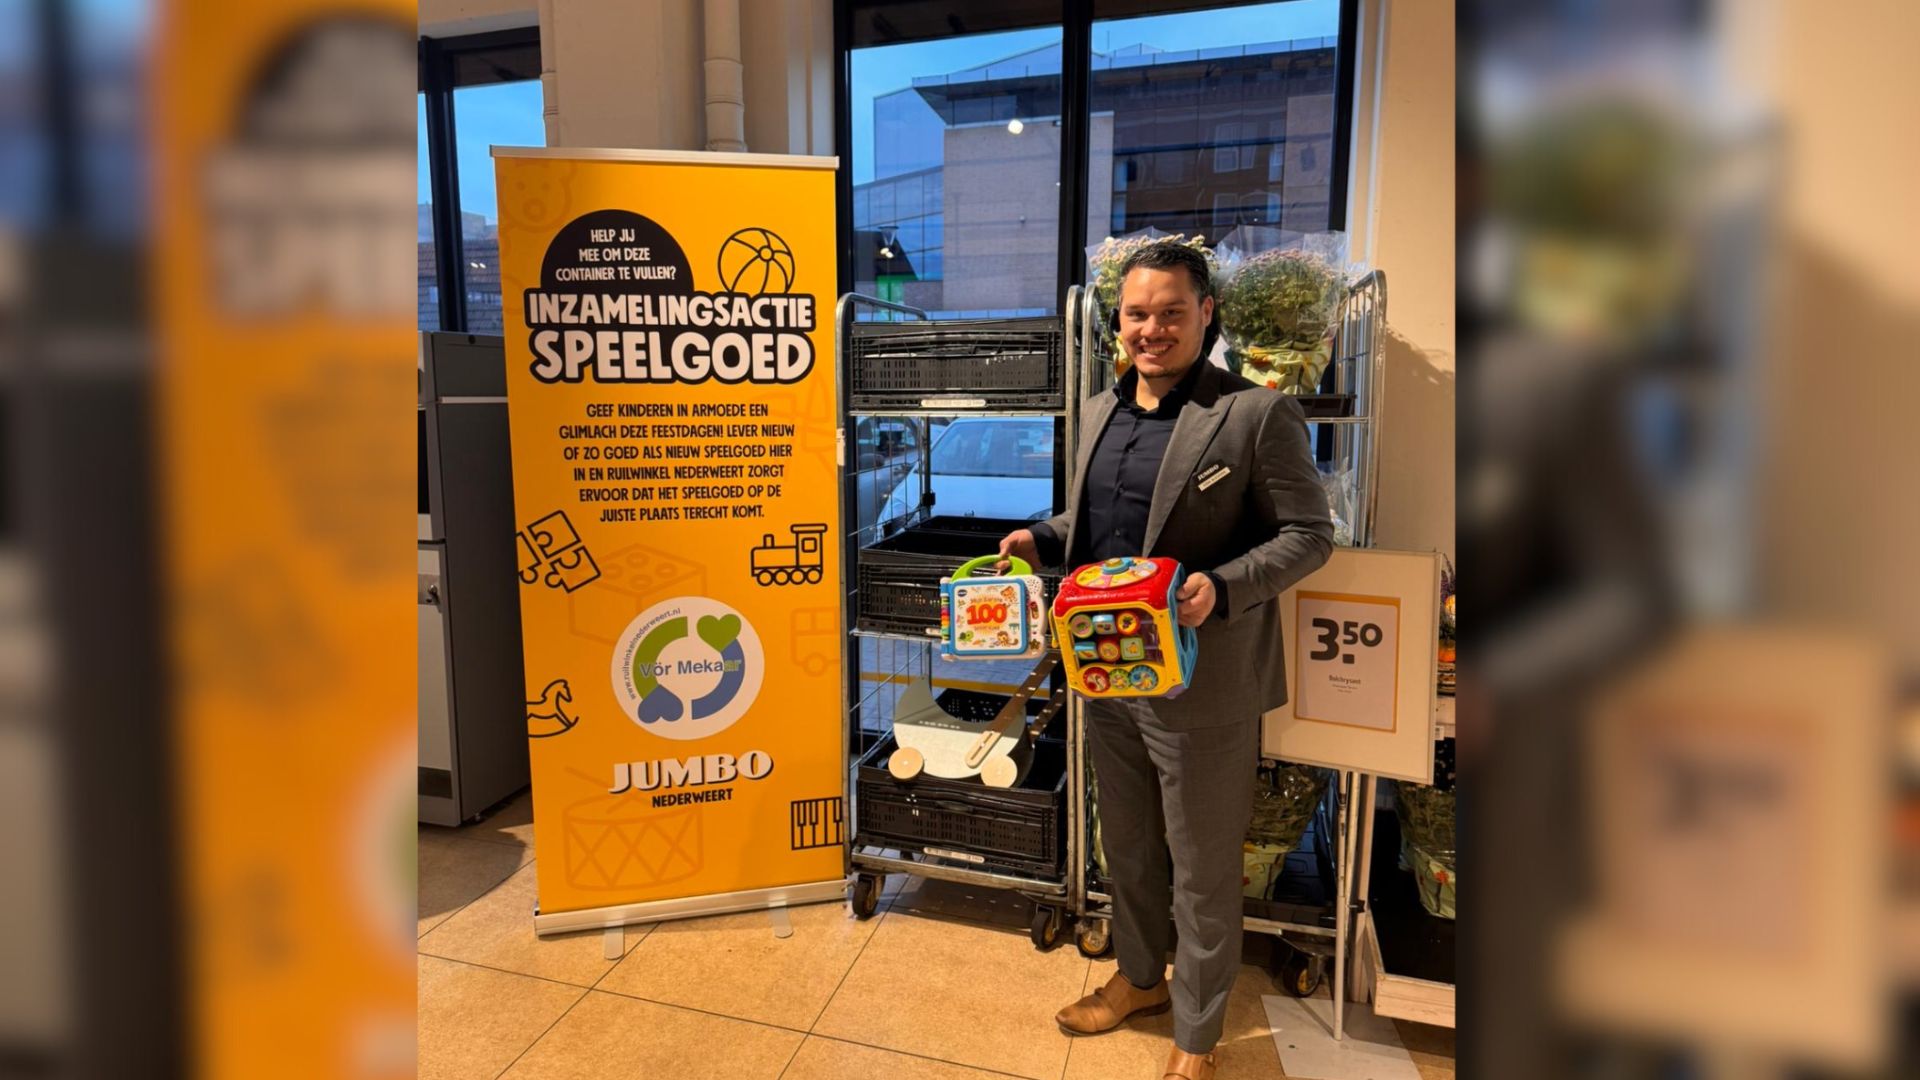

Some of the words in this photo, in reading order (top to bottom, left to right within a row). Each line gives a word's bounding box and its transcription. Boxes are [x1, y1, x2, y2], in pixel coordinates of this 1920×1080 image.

[590, 229, 616, 243] HELP
[619, 229, 635, 242] JIJ
[579, 248, 600, 262] MEE
[602, 248, 621, 261] OM
[624, 247, 650, 261] DEZE
[556, 267, 615, 281] CONTAINER
[619, 267, 631, 280] TE
[633, 266, 676, 280] VULLEN?
[528, 294, 812, 328] INZAMELINGSACTIE
[534, 330, 812, 380] SPEELGOED
[587, 404, 614, 417] GEEF
[618, 404, 673, 417] KINDEREN
[677, 404, 688, 417] IN
[692, 404, 746, 416] ARMOEDE
[749, 404, 768, 416] EEN
[559, 426, 616, 439] GLIMLACH
[620, 425, 648, 438] DEZE
[652, 425, 723, 438] FEESTDAGEN!
[727, 425, 758, 437] LEVER
[761, 424, 795, 436] NIEUW
[564, 447, 579, 460] OF
[583, 447, 600, 459] ZO
[604, 447, 638, 459] GOED
[643, 446, 662, 459] ALS
[666, 446, 700, 459] NIEUW
[704, 445, 765, 458] SPEELGOED
[769, 444, 792, 457] HIER
[574, 468, 585, 481] IN
[589, 467, 603, 480] EN
[607, 466, 670, 480] RUILWINKEL
[674, 465, 744, 478] NEDERWEERT
[748, 465, 784, 477] ZORGT
[580, 488, 628, 502] ERVOOR
[633, 488, 654, 500] DAT
[658, 487, 678, 500] HET
[682, 486, 744, 499] SPEELGOED
[748, 485, 764, 498] OP
[767, 485, 781, 497] DE
[600, 509, 636, 522] JUISTE
[640, 507, 679, 521] PLAATS
[683, 506, 728, 519] TERECHT
[732, 505, 764, 518] KOMT.
[966, 604, 1007, 625] 100
[622, 607, 681, 700] www.ruilwinkelnederweert.nl
[640, 661, 671, 677] Vör
[608, 750, 774, 794] JUMBO
[652, 788, 733, 808] NEDERWEERT
